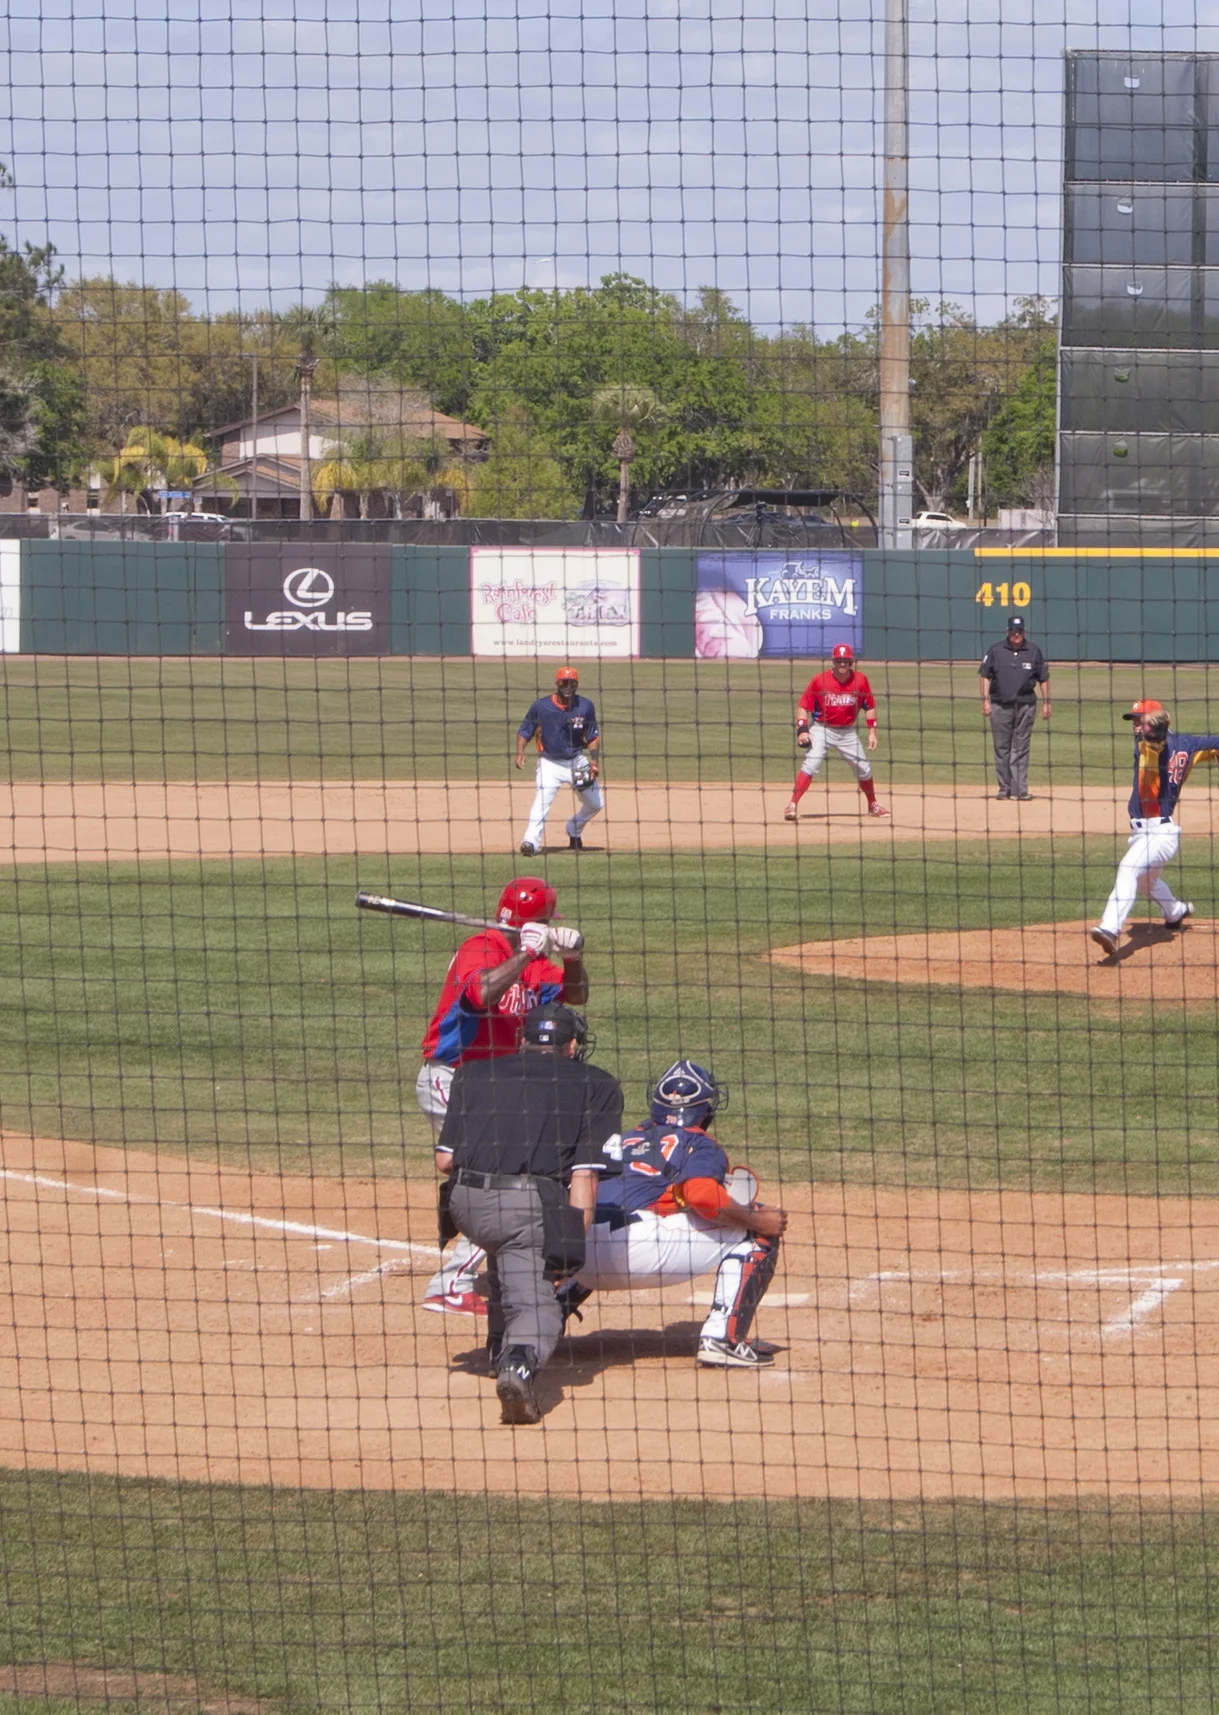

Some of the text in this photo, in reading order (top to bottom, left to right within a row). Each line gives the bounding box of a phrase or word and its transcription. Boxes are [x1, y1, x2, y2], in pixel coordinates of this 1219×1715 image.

[480, 579, 557, 605] Rainforest
[744, 576, 857, 617] KAYEM
[975, 581, 1031, 607] 410
[244, 611, 373, 631] LEXUS
[769, 609, 832, 620] FRANKS
